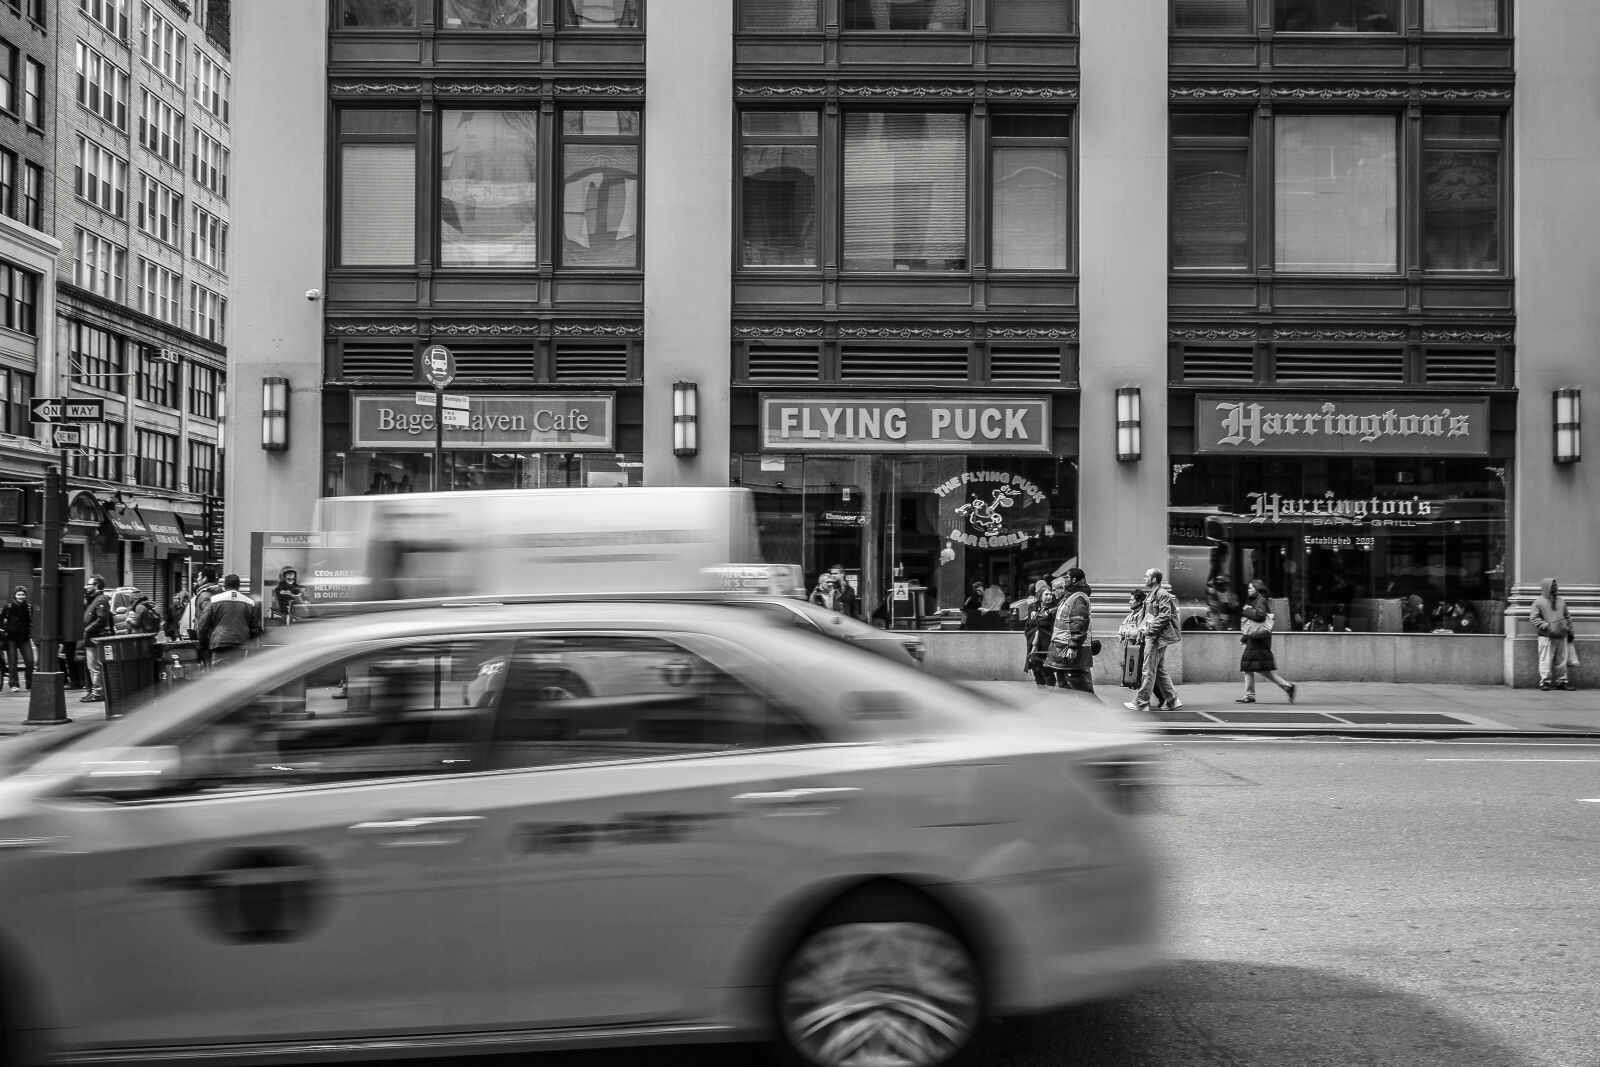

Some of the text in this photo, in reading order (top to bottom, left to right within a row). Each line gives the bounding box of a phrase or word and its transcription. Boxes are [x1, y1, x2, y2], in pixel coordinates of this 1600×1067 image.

[43, 406, 94, 416] ON WAY
[377, 408, 437, 435] Bage
[447, 410, 526, 432] aven
[534, 409, 589, 432] Cafe
[781, 407, 1029, 440] FLYING PUCK
[1215, 402, 1470, 447] Harrington's
[933, 471, 1046, 503] THE FLYING PUCK
[1246, 490, 1432, 523] Harrington's
[1313, 518, 1345, 526] BAR
[1371, 519, 1416, 527] GRILL
[950, 529, 1029, 548] BAR & GRILL
[1304, 535, 1351, 545] Established
[895, 584, 906, 596] A
